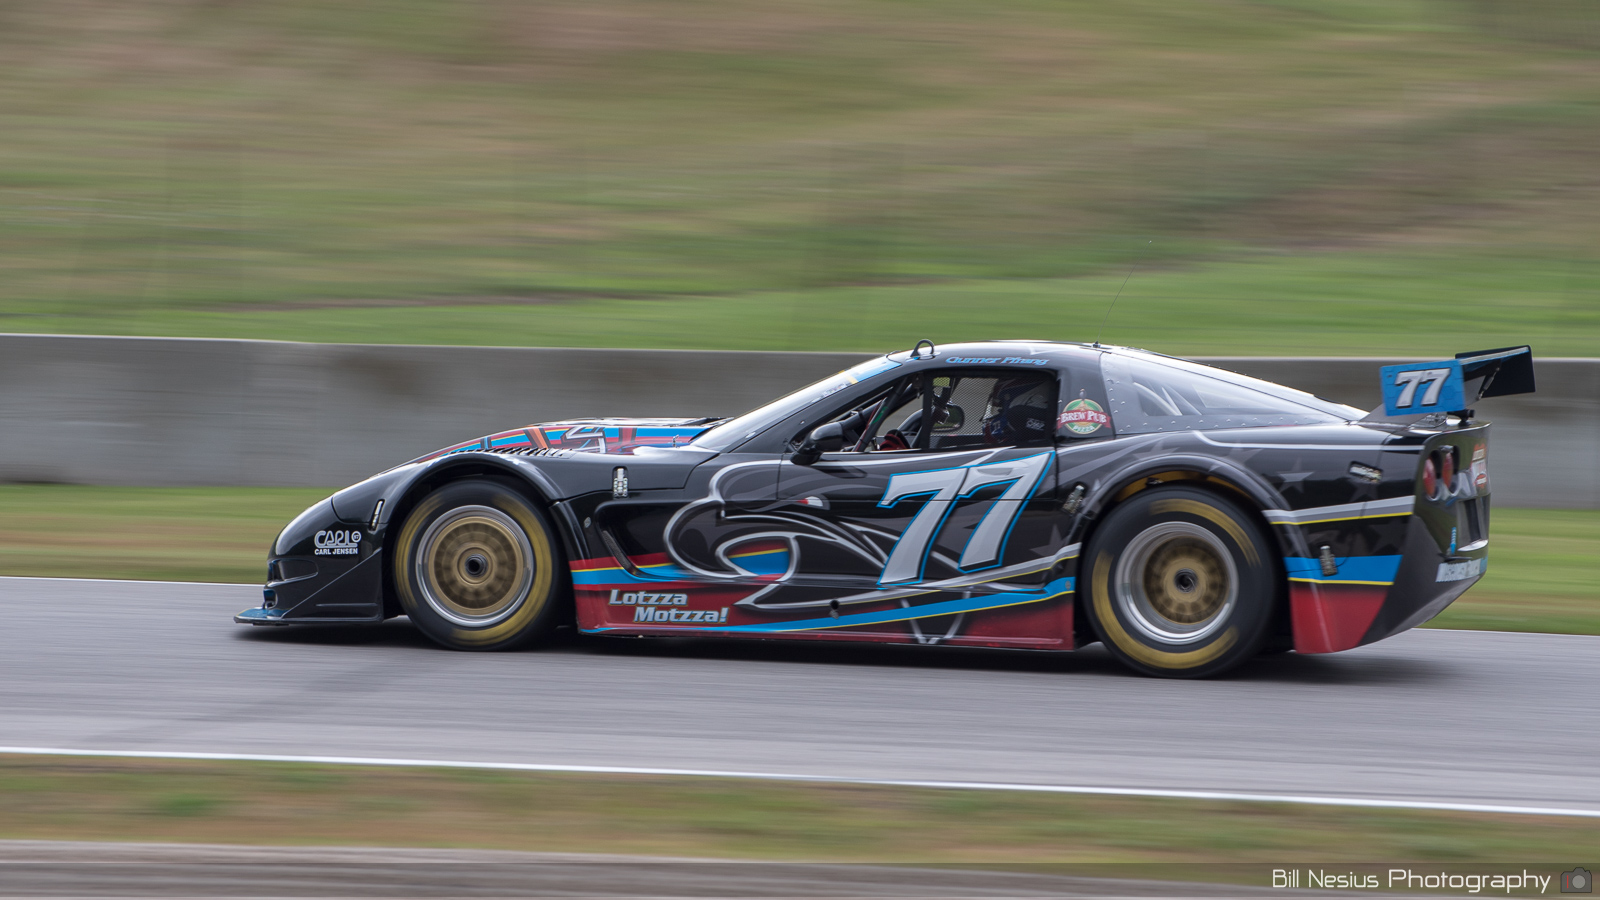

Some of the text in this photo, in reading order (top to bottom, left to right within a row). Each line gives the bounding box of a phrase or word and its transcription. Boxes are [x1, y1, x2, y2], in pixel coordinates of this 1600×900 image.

[945, 356, 1001, 364] Gunner
[1395, 367, 1451, 408] 77
[876, 450, 1056, 587] 77
[609, 589, 688, 605] Lotzza
[632, 606, 730, 623] Motzza!
